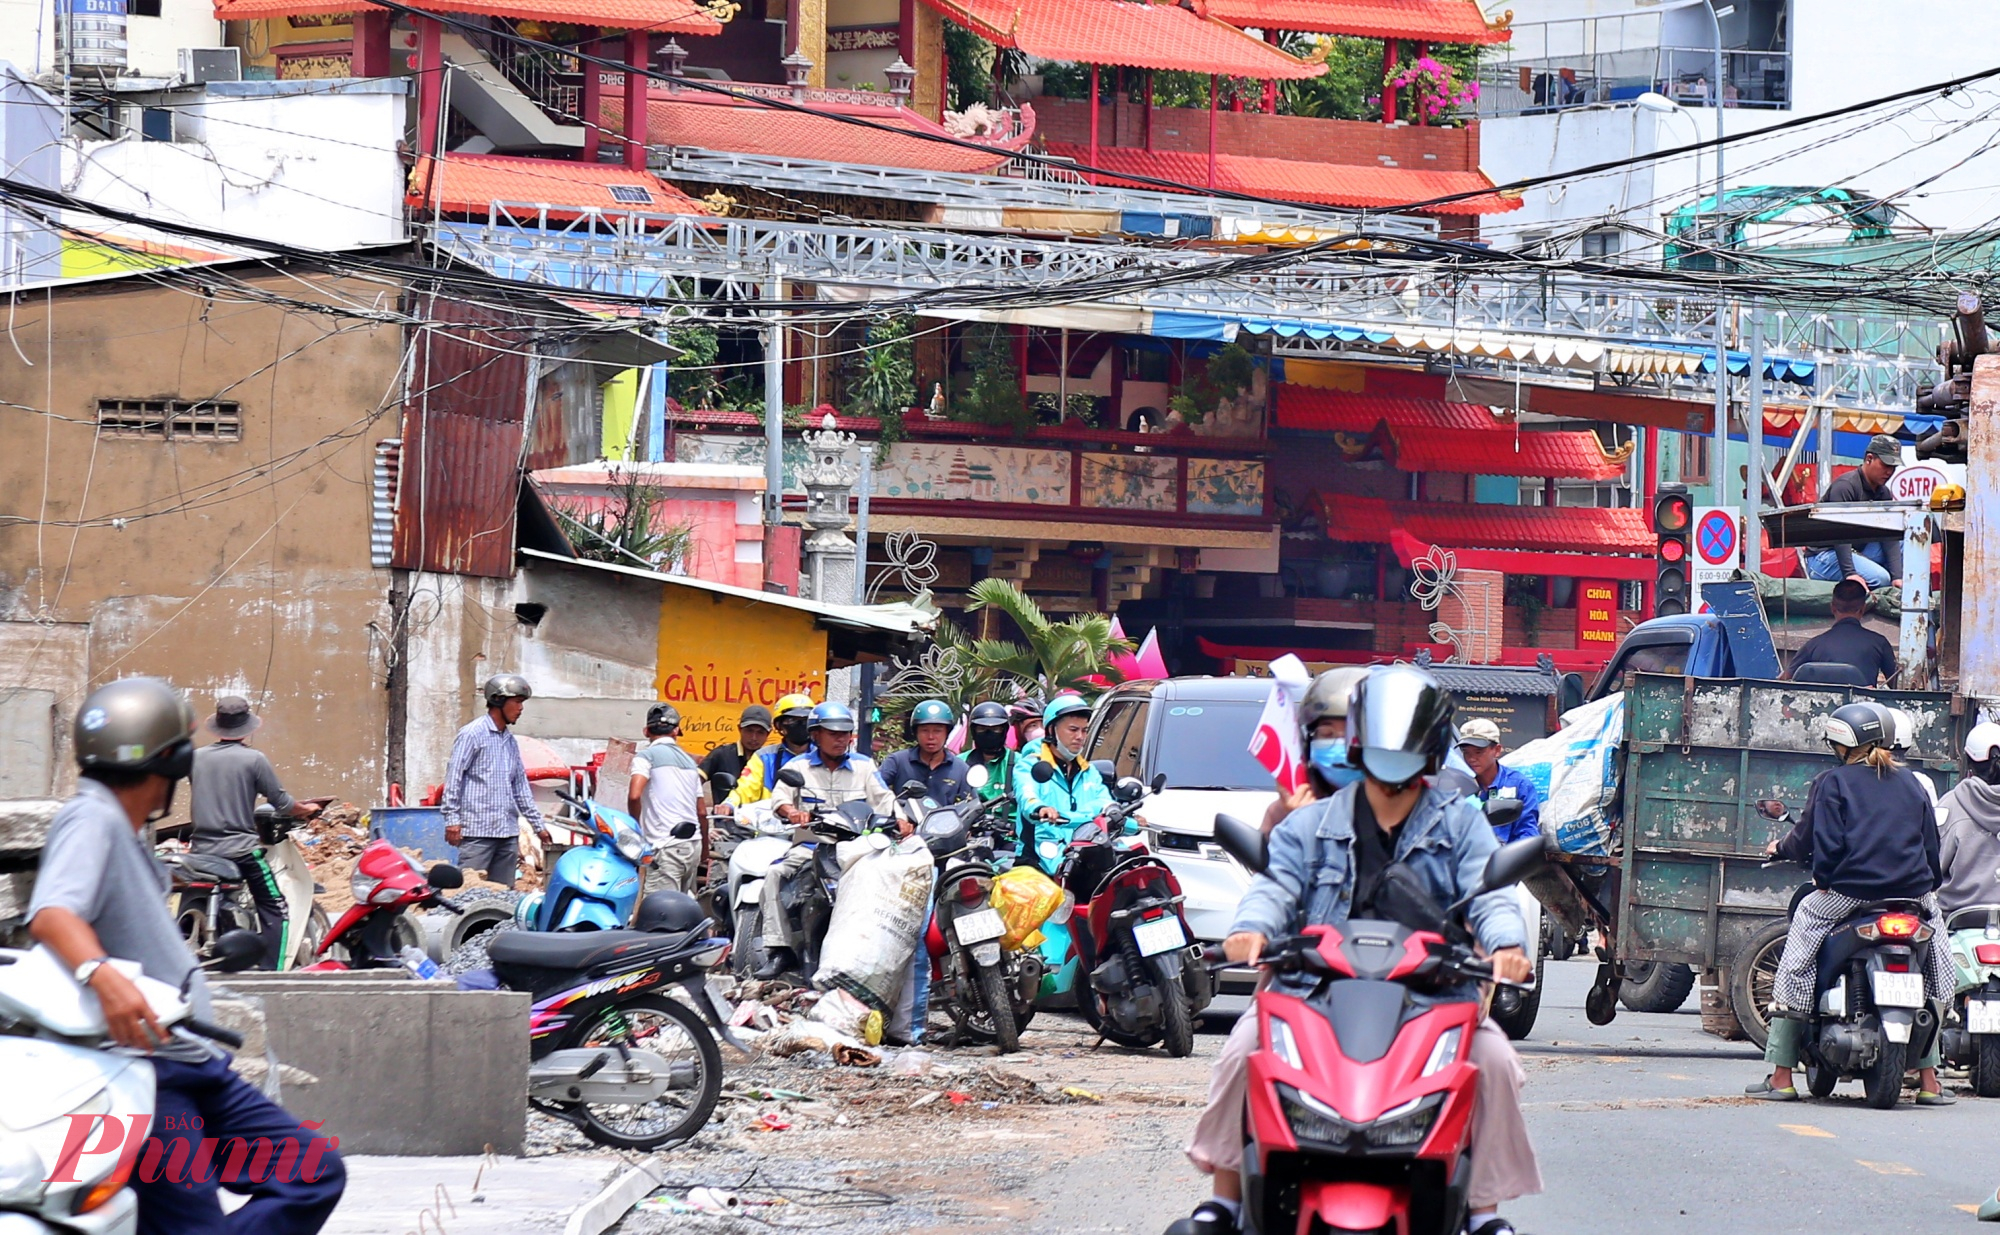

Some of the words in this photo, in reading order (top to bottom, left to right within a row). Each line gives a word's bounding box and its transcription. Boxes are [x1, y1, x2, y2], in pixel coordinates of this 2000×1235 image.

[1671, 501, 1686, 527] 5
[1586, 587, 1612, 600] CHÙA
[1589, 609, 1609, 621] HÒA
[1582, 629, 1615, 642] KHÁNH
[725, 669, 754, 704] LÁ
[585, 972, 648, 999] Wave
